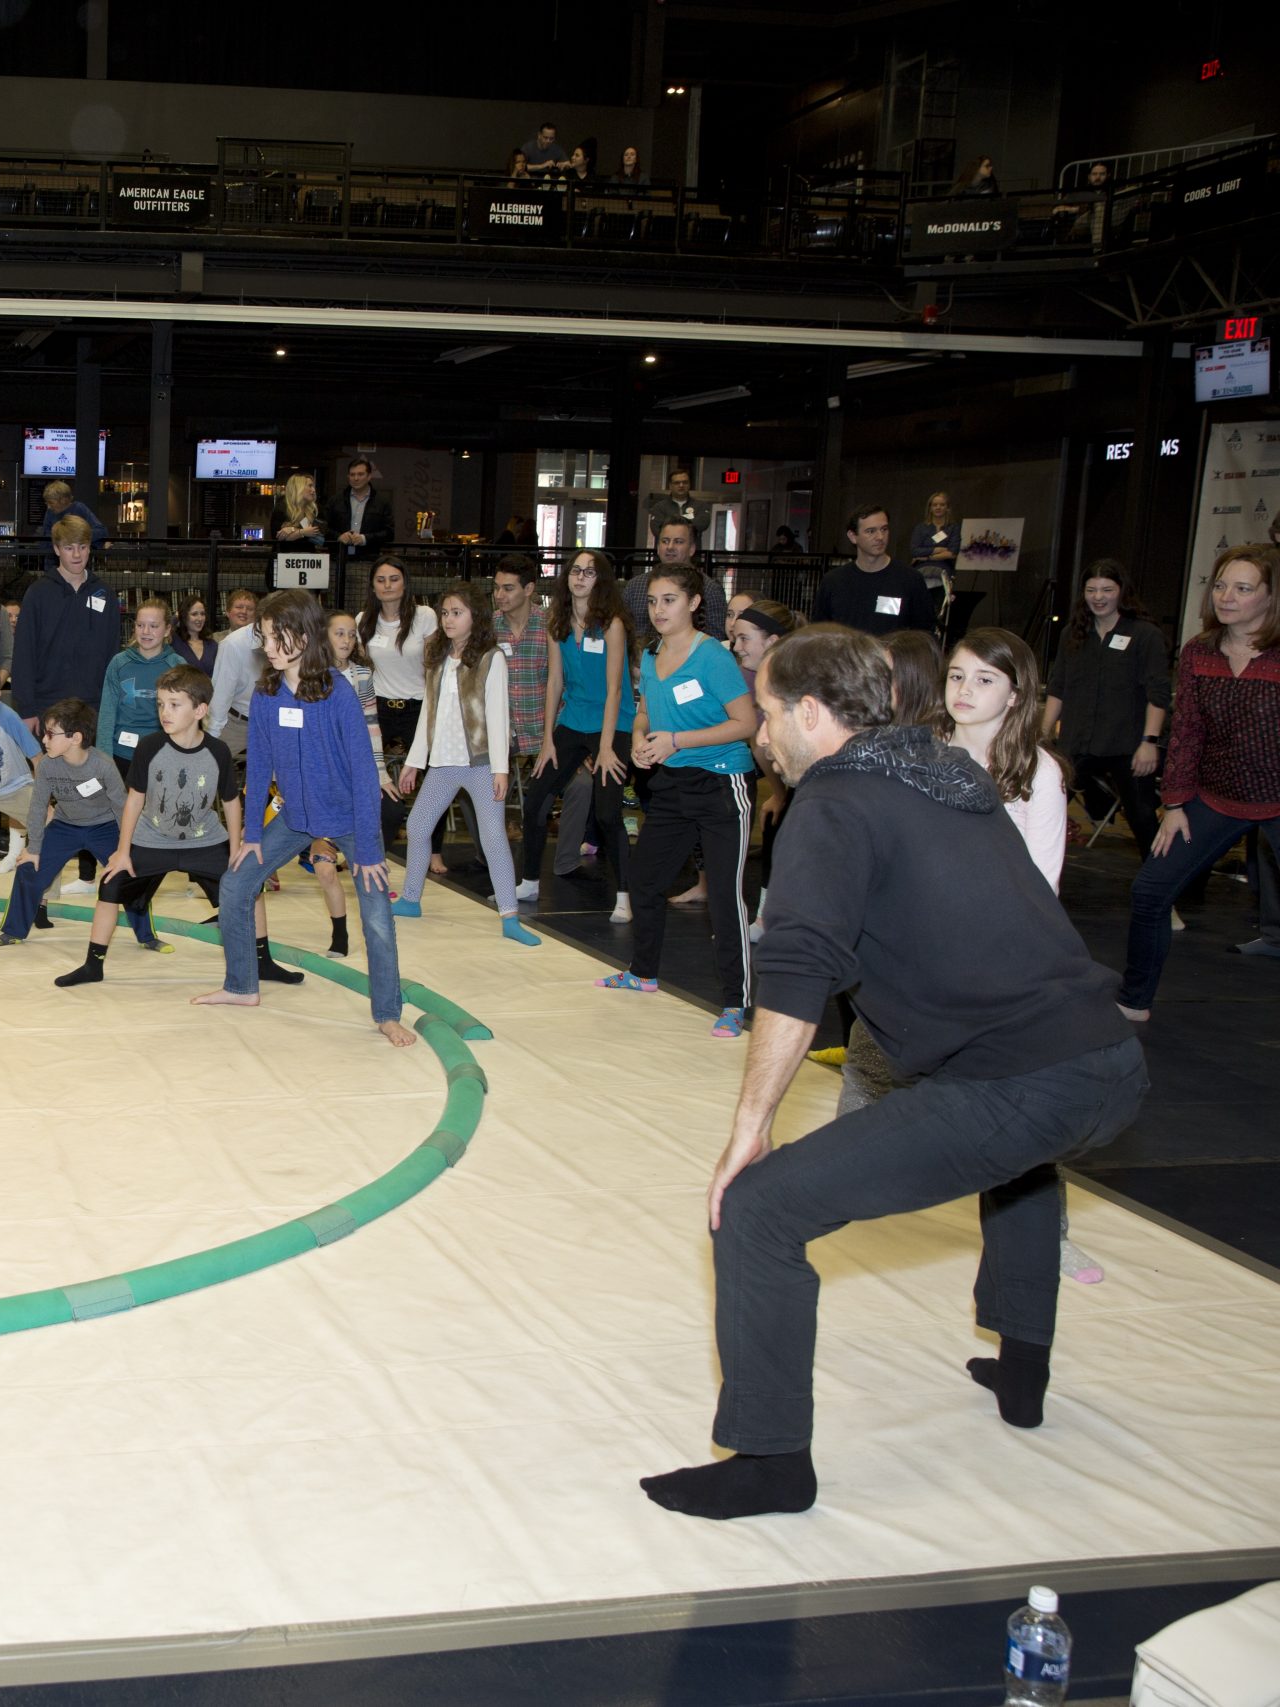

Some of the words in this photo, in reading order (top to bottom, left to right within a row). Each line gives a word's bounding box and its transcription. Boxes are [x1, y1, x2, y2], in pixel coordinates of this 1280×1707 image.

[119, 187, 170, 199] AMERICAN
[173, 189, 205, 200] EAGLE
[1184, 186, 1212, 203] COORS
[1216, 178, 1242, 195] LIGHT
[133, 200, 190, 212] OUTFITTERS
[489, 202, 543, 215] ALLEGHENY
[489, 213, 543, 226] PETROLEUM
[927, 221, 1002, 234] McDONALD'S
[1224, 317, 1258, 340] EXIT
[285, 558, 322, 569] SECTION
[298, 571, 307, 586] B
